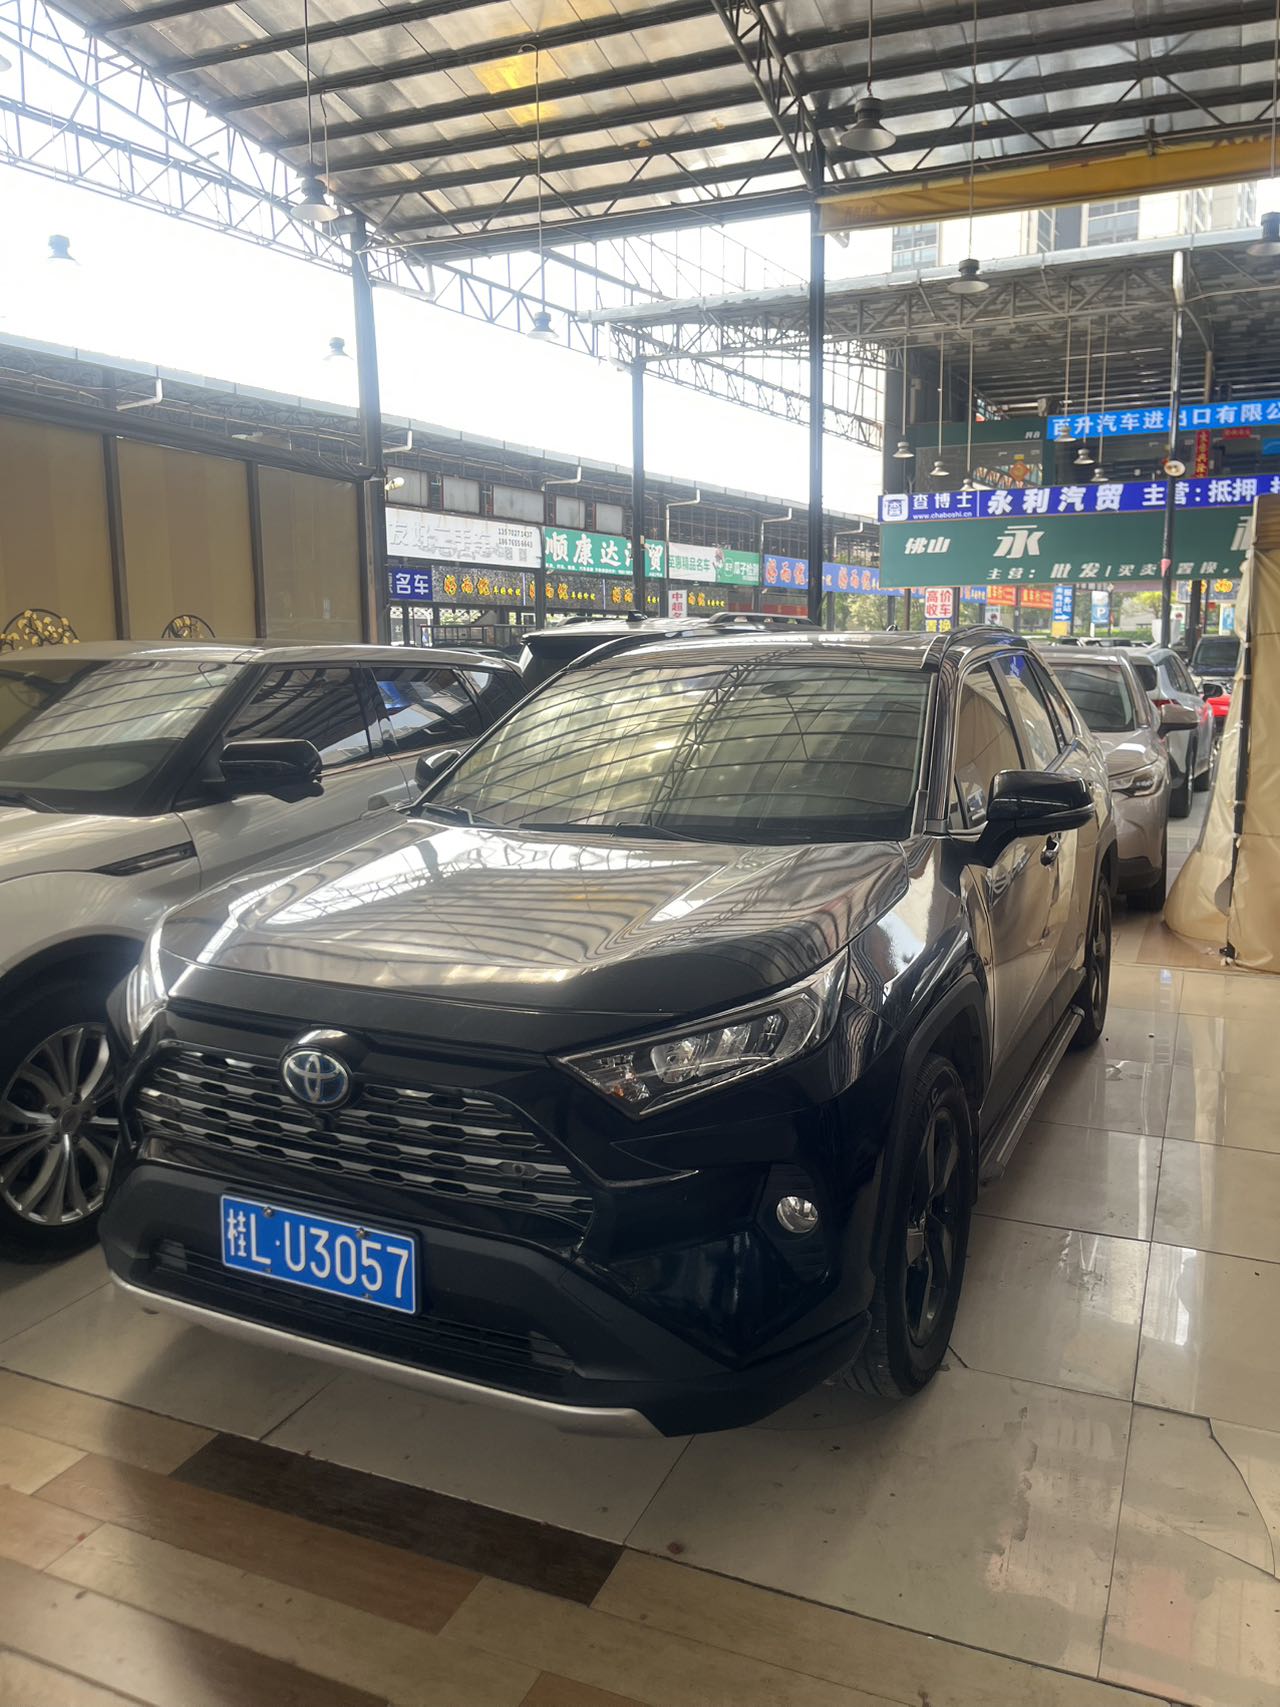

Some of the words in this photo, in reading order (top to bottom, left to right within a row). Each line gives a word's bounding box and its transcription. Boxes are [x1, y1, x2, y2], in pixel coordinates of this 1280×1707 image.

[912, 492, 973, 510] 查博士
[987, 484, 1124, 515] 永利汽贸
[912, 511, 973, 520] www.chaboshi.cn
[904, 536, 951, 555] 佛山
[993, 525, 1044, 559] 永
[388, 572, 429, 596] 名车
[926, 589, 952, 602] 高价
[926, 603, 952, 617] 收车
[227, 1208, 409, 1299] 桂L·U3057
